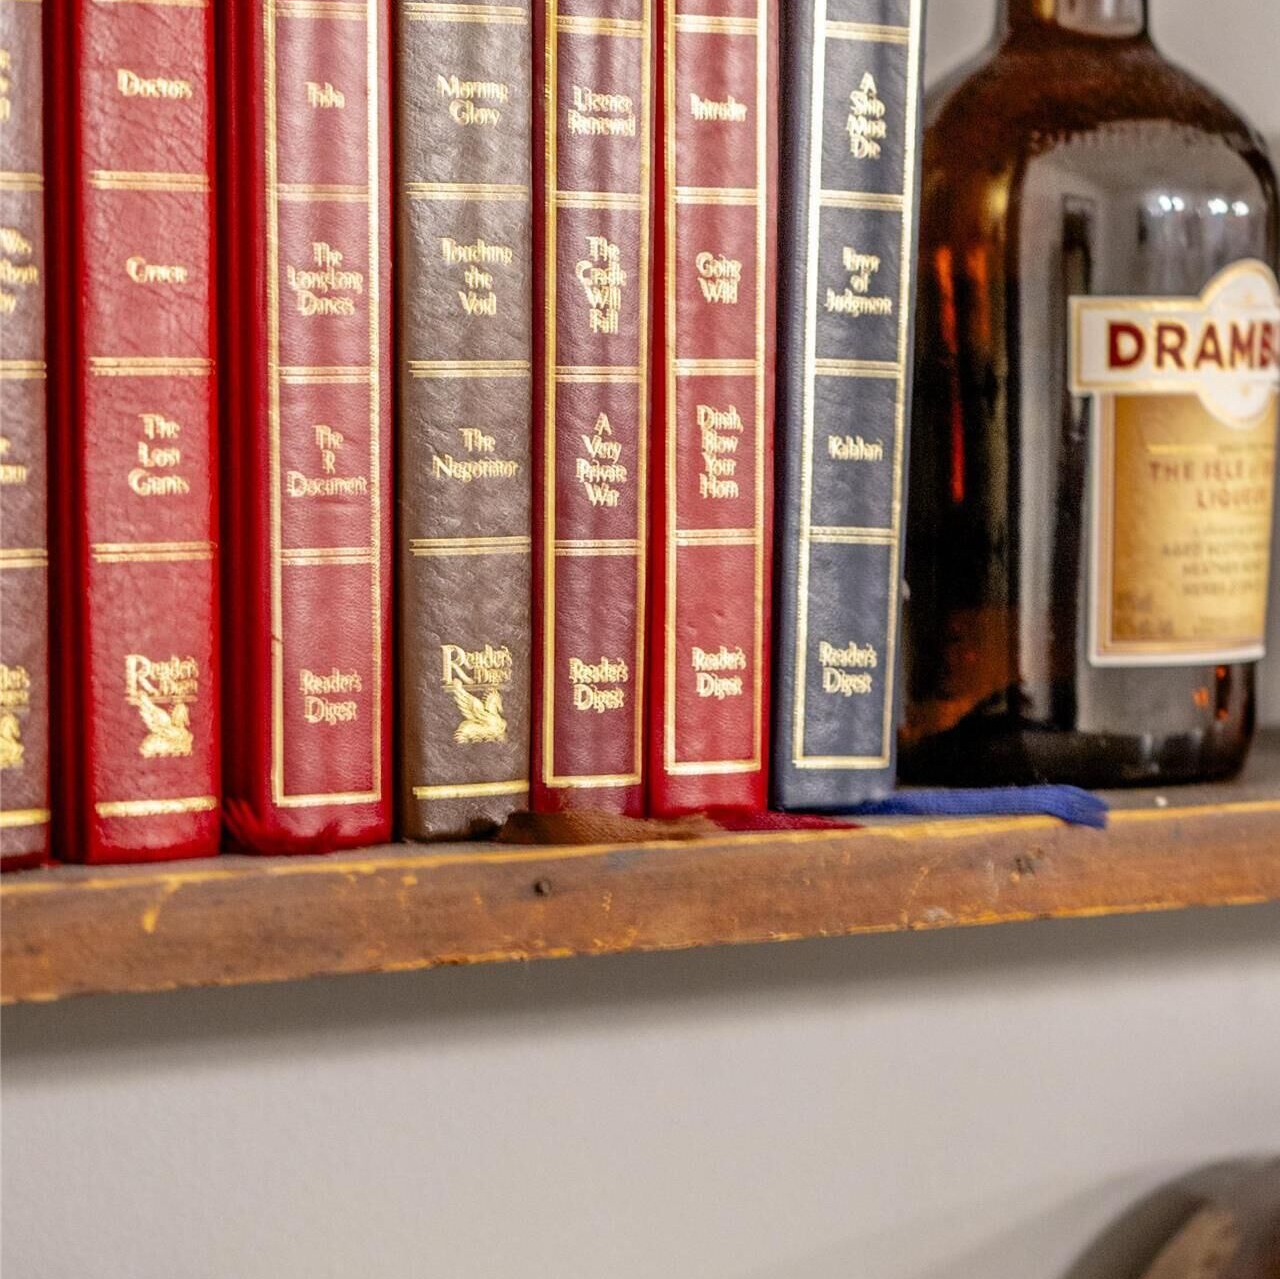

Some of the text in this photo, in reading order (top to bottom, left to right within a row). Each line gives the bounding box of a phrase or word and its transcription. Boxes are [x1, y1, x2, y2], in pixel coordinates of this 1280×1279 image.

[117, 68, 193, 100] Doctors
[437, 74, 508, 104] Morning
[860, 71, 877, 94] A
[449, 98, 501, 128] Glory
[849, 89, 886, 119] Ship
[567, 108, 636, 137] Renewed
[850, 133, 882, 160] Die
[312, 241, 343, 267] The
[437, 237, 513, 266] Touching
[585, 236, 621, 261] The
[464, 265, 493, 290] the
[575, 260, 627, 288] Cradle
[695, 251, 742, 283] Going
[584, 282, 622, 311] Will
[697, 276, 739, 305] Wild
[850, 272, 870, 293] of
[459, 290, 497, 317] Void
[824, 287, 893, 318] Judgment
[138, 413, 180, 440] The
[312, 425, 344, 450] The
[594, 411, 612, 436] A
[138, 440, 180, 468] Lost
[459, 427, 497, 453] The
[582, 434, 622, 465] Very
[701, 429, 739, 454] Blow
[322, 449, 336, 474] R
[432, 454, 519, 483] Negotiator
[576, 457, 628, 483] Private
[702, 451, 737, 477] Your
[287, 471, 367, 498] Document
[699, 473, 740, 499] Horn
[440, 643, 513, 684] Reader's
[692, 645, 747, 672] Reader's
[819, 640, 878, 669] Reader's
[124, 653, 199, 696] Reader's
[300, 667, 362, 695] Reader's
[473, 668, 513, 685] Digest
[568, 656, 629, 685] Reader's
[822, 667, 873, 698] Digest
[572, 683, 625, 714] Digest
[696, 672, 743, 700] Digest
[304, 696, 357, 726] Digest
